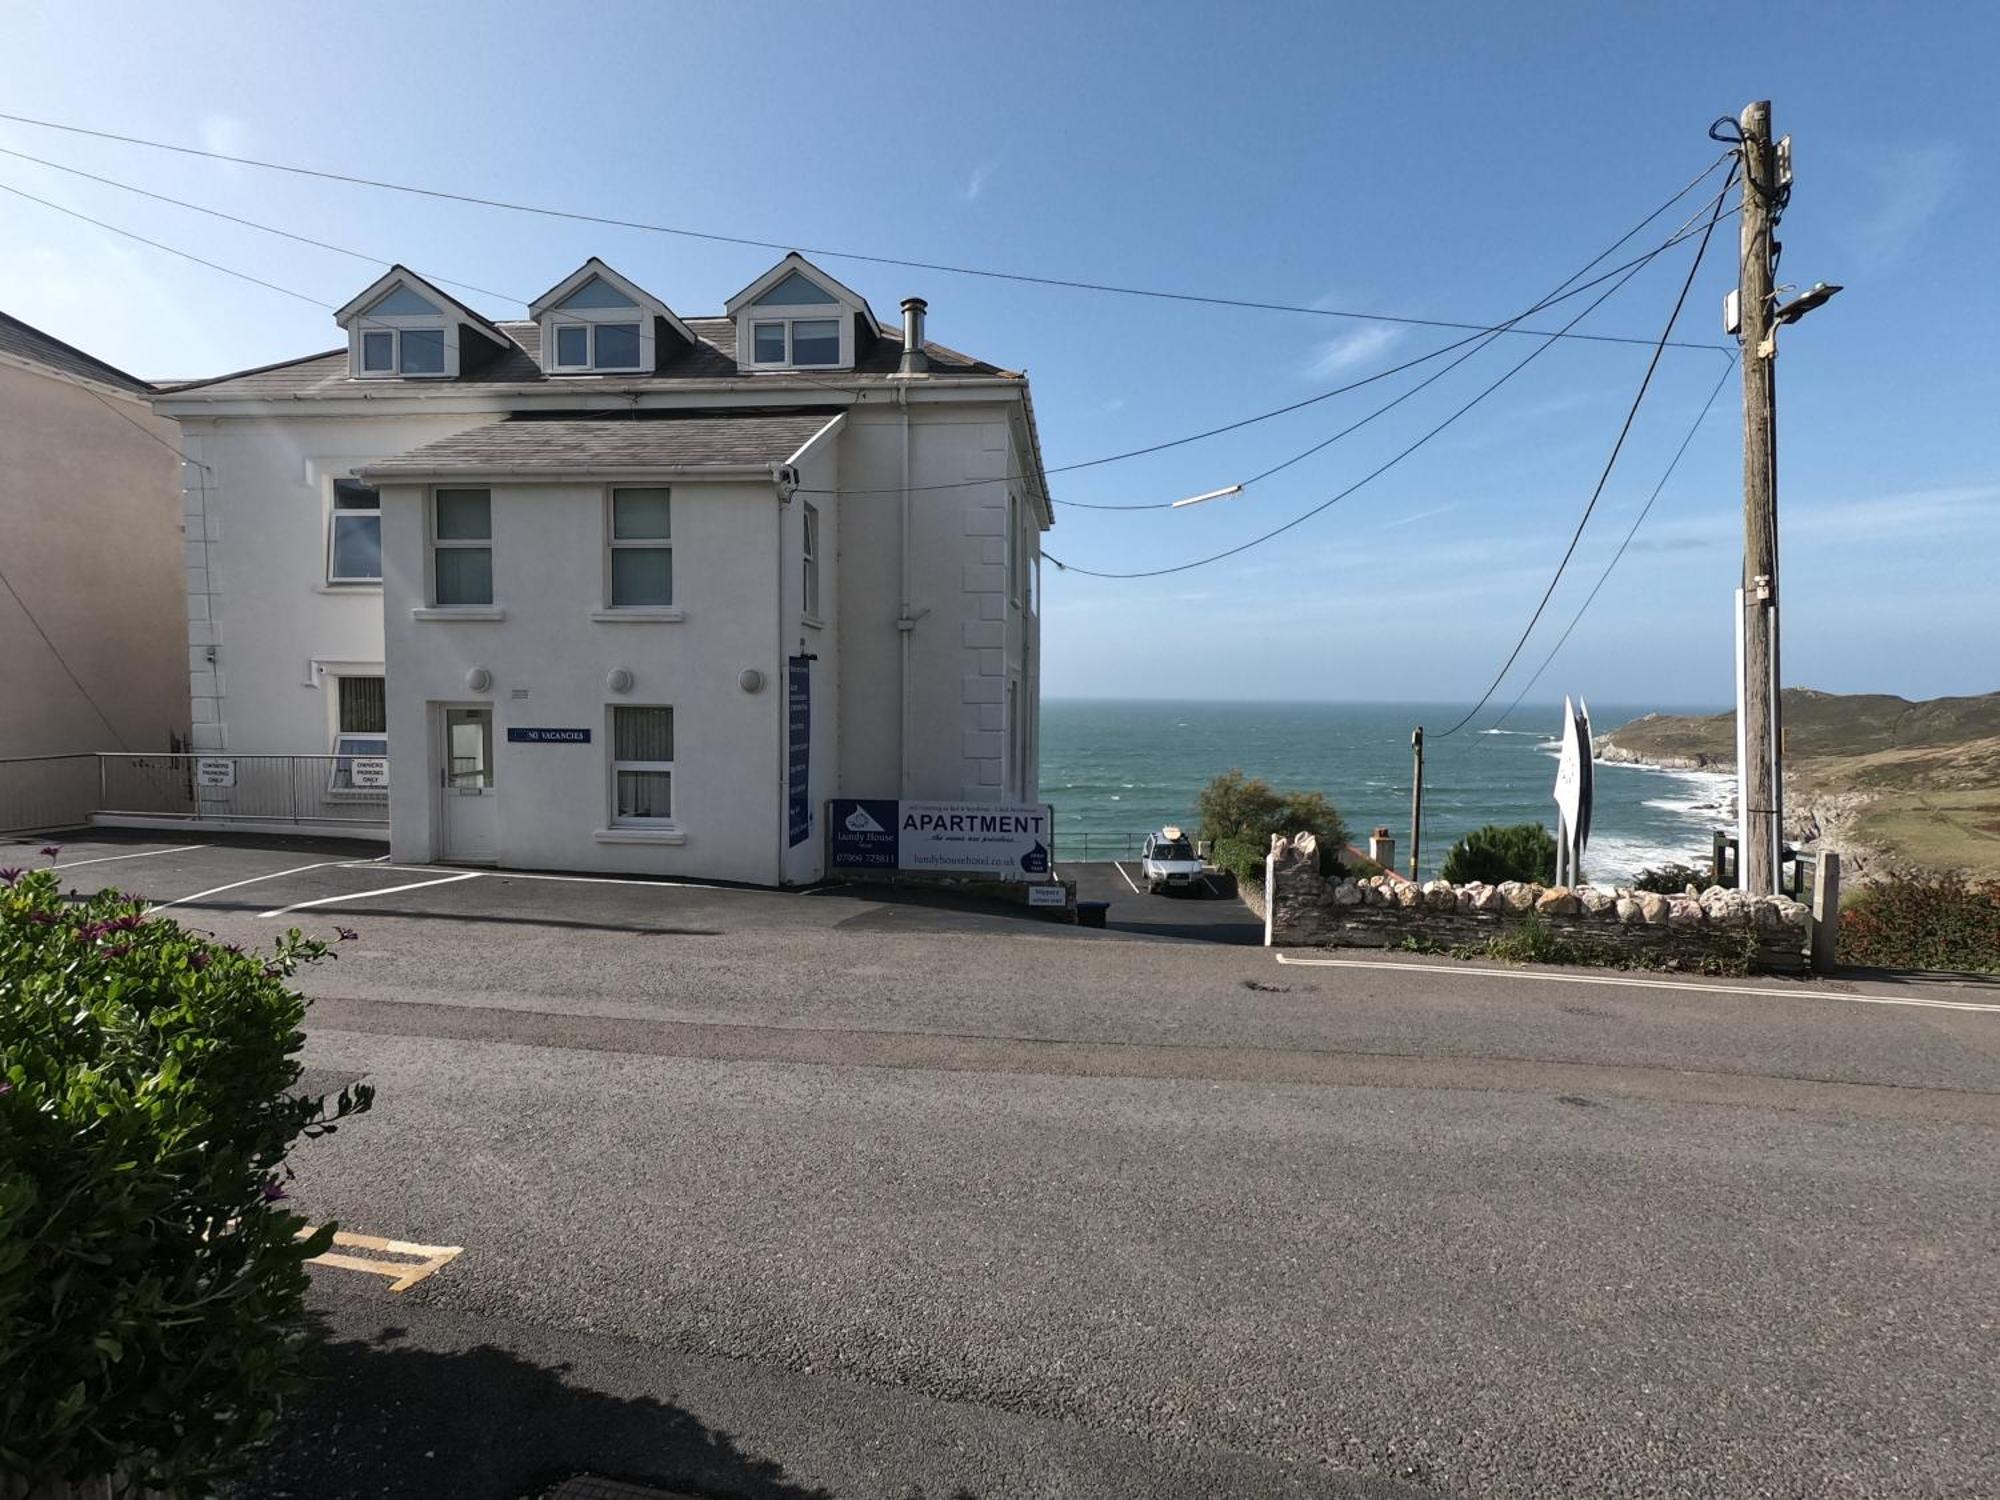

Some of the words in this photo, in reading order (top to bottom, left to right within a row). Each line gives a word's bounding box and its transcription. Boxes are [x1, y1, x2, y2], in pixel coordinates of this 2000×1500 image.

[541, 731, 584, 740] VACANCIES
[903, 814, 1044, 834] APARTMENT
[866, 831, 894, 842] House
